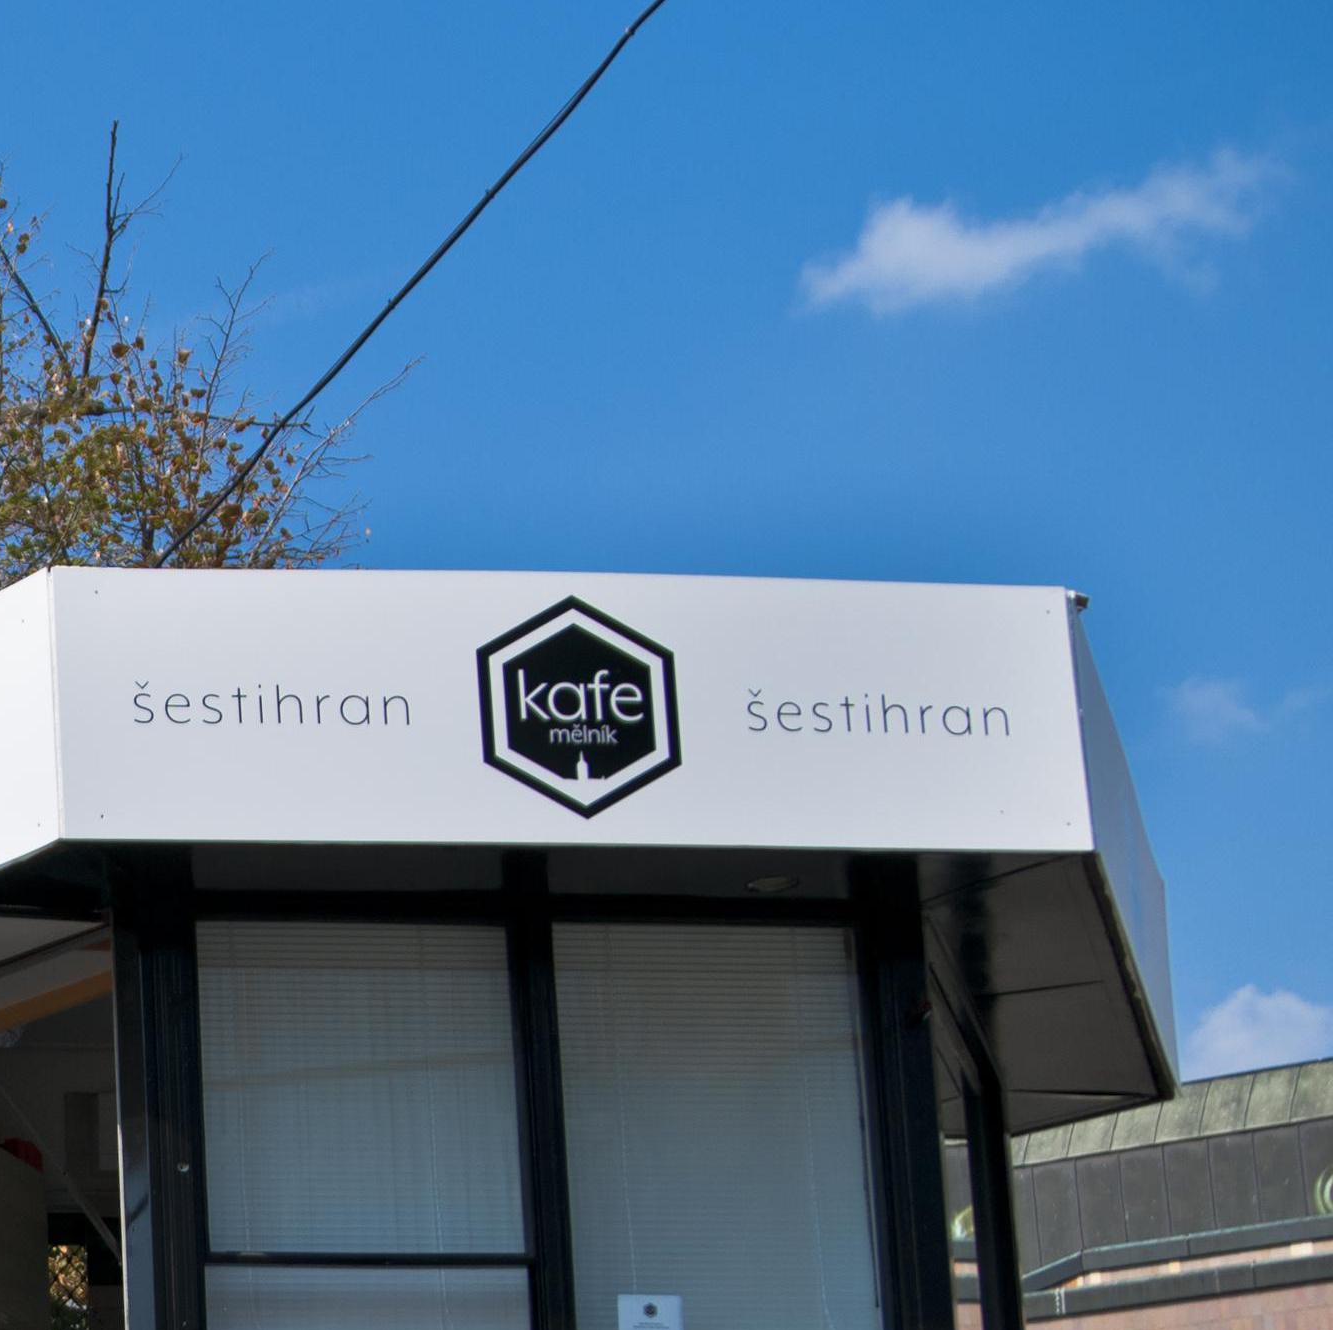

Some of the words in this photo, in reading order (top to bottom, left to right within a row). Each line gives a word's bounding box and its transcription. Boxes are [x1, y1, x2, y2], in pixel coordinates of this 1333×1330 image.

[132, 679, 412, 727] šestihran
[517, 668, 645, 722] kafe
[745, 687, 1011, 738] šestihran
[548, 723, 619, 745] mělník
